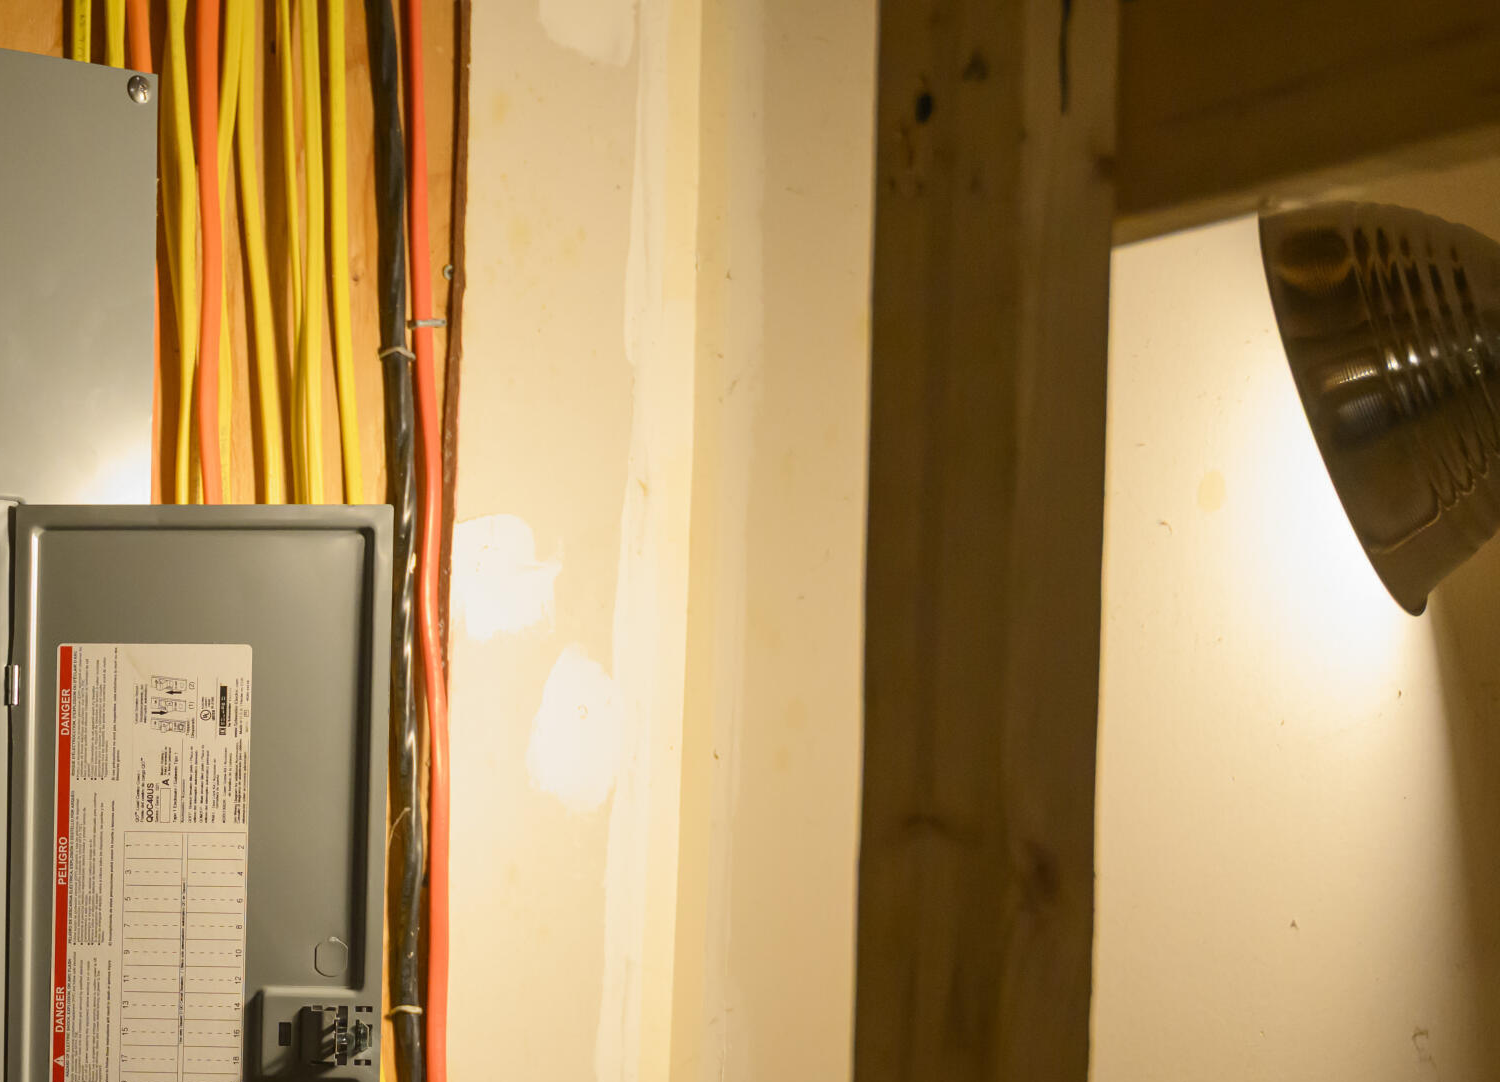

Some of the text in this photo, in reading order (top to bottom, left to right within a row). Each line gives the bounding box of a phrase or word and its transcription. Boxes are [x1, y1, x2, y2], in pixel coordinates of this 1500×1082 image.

[60, 688, 71, 736] DANGER
[146, 783, 154, 823] QOC40US
[58, 836, 68, 885] PELIGRO
[236, 948, 242, 958] 10
[123, 975, 130, 983] 11
[235, 976, 241, 984] 12
[122, 1000, 128, 1009] 13
[235, 1002, 241, 1011] 14
[56, 986, 64, 1033] DANGER
[122, 1027, 128, 1036] 15
[121, 1055, 127, 1063] 17
[233, 1056, 240, 1065] 18
